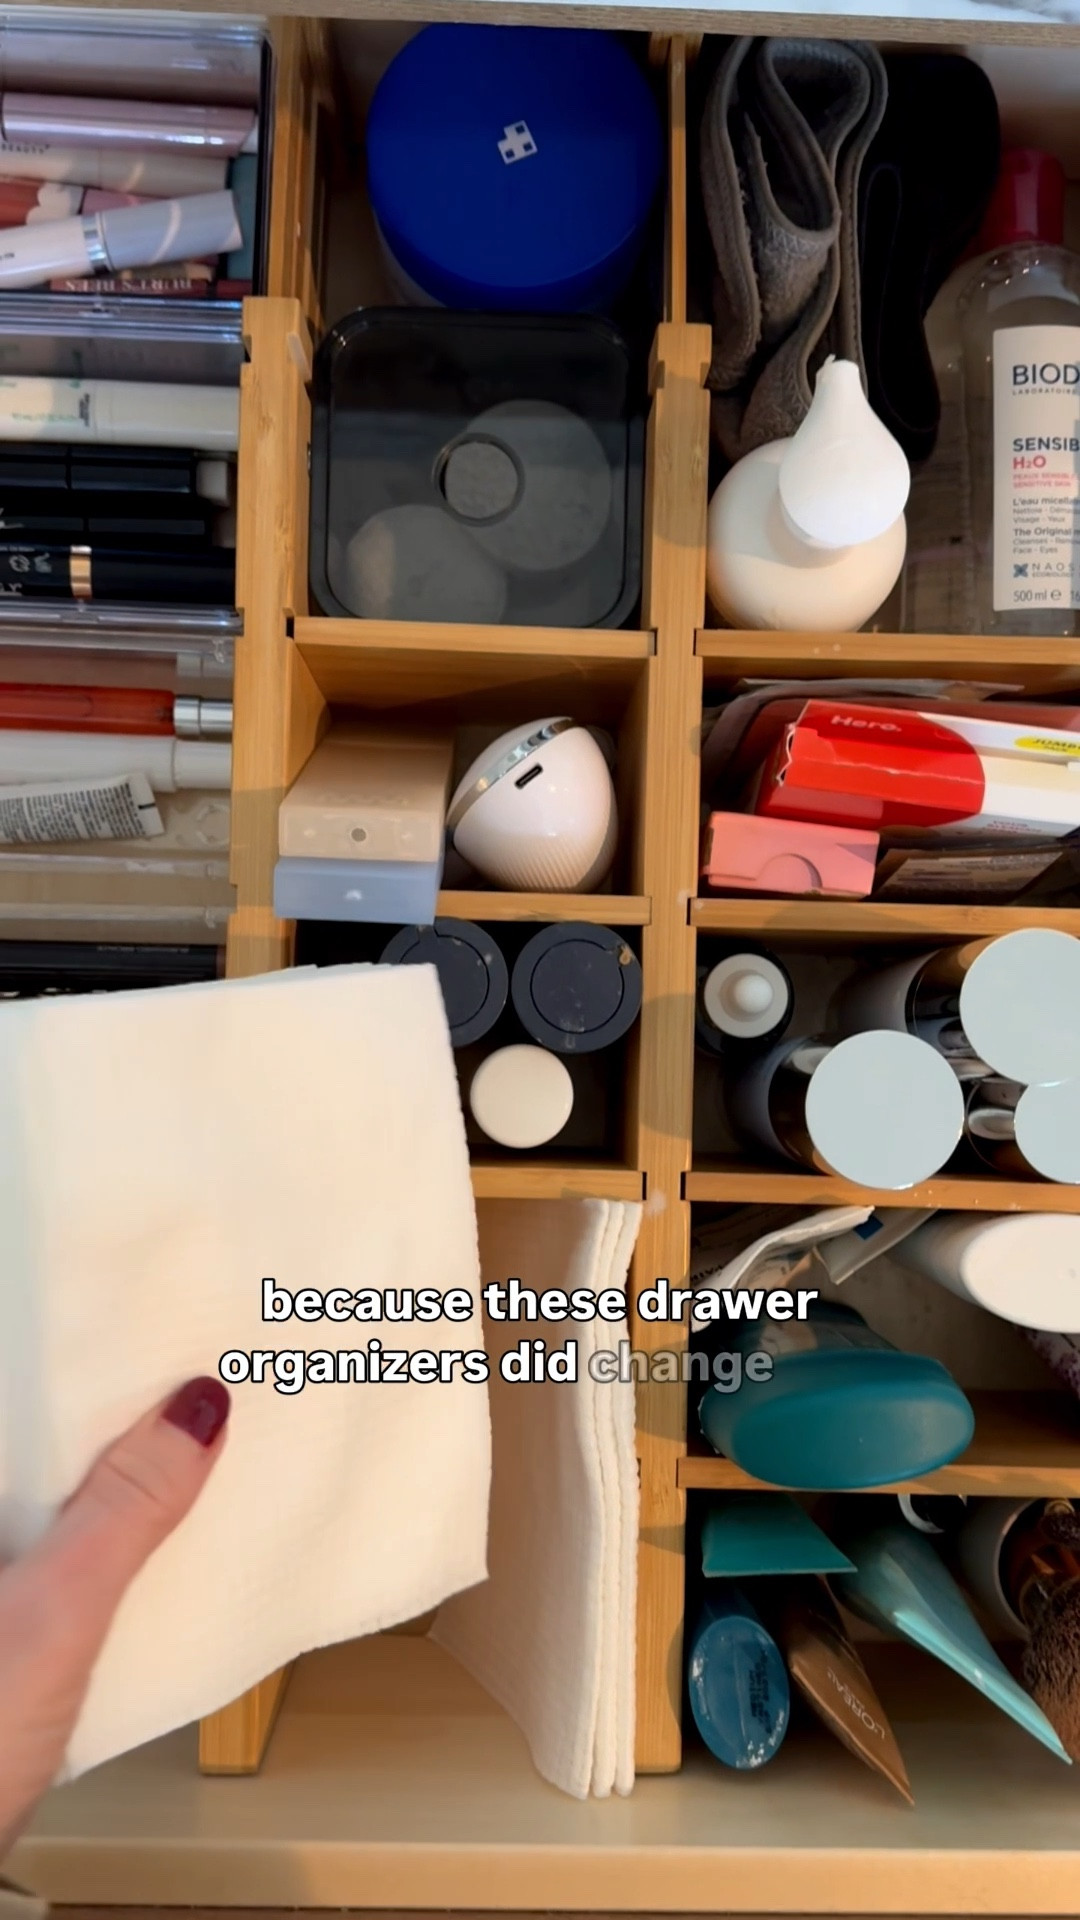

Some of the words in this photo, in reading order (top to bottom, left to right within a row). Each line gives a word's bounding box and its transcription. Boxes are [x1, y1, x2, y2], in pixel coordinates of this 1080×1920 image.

[1012, 363, 1080, 386] BIOD
[1013, 437, 1080, 452] SENSIB
[1013, 528, 1032, 537] The
[1034, 527, 1072, 537] Original
[1032, 562, 1075, 572] NAOS
